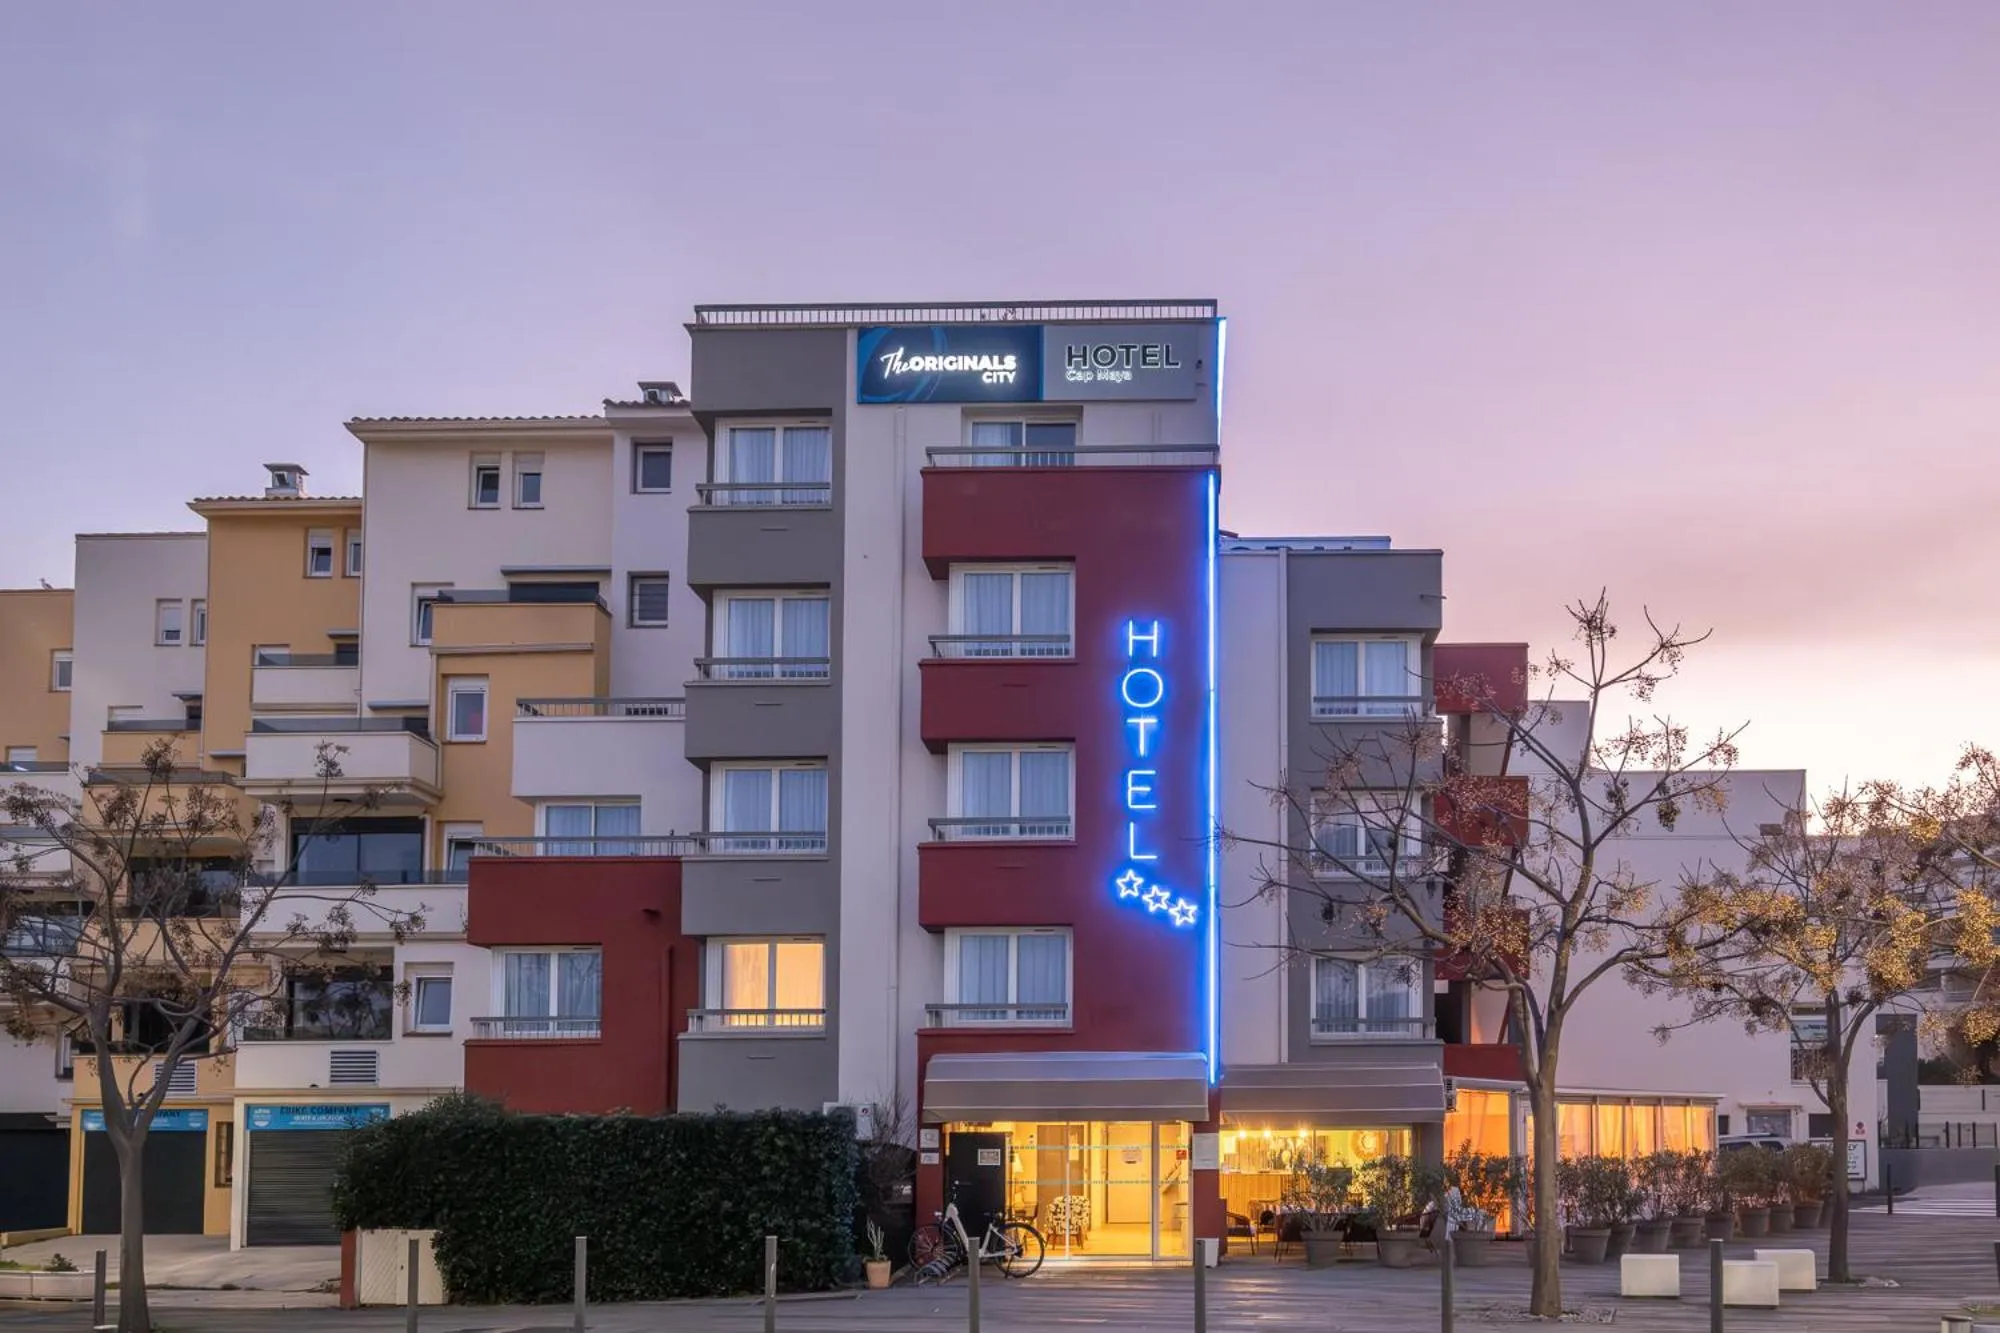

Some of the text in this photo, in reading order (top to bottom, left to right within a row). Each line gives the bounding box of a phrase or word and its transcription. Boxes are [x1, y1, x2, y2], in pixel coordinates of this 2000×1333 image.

[1066, 343, 1181, 369] HOTEL
[982, 371, 1016, 384] CITY
[1065, 369, 1133, 383] Cap Maya
[1122, 620, 1163, 860] HOTEL
